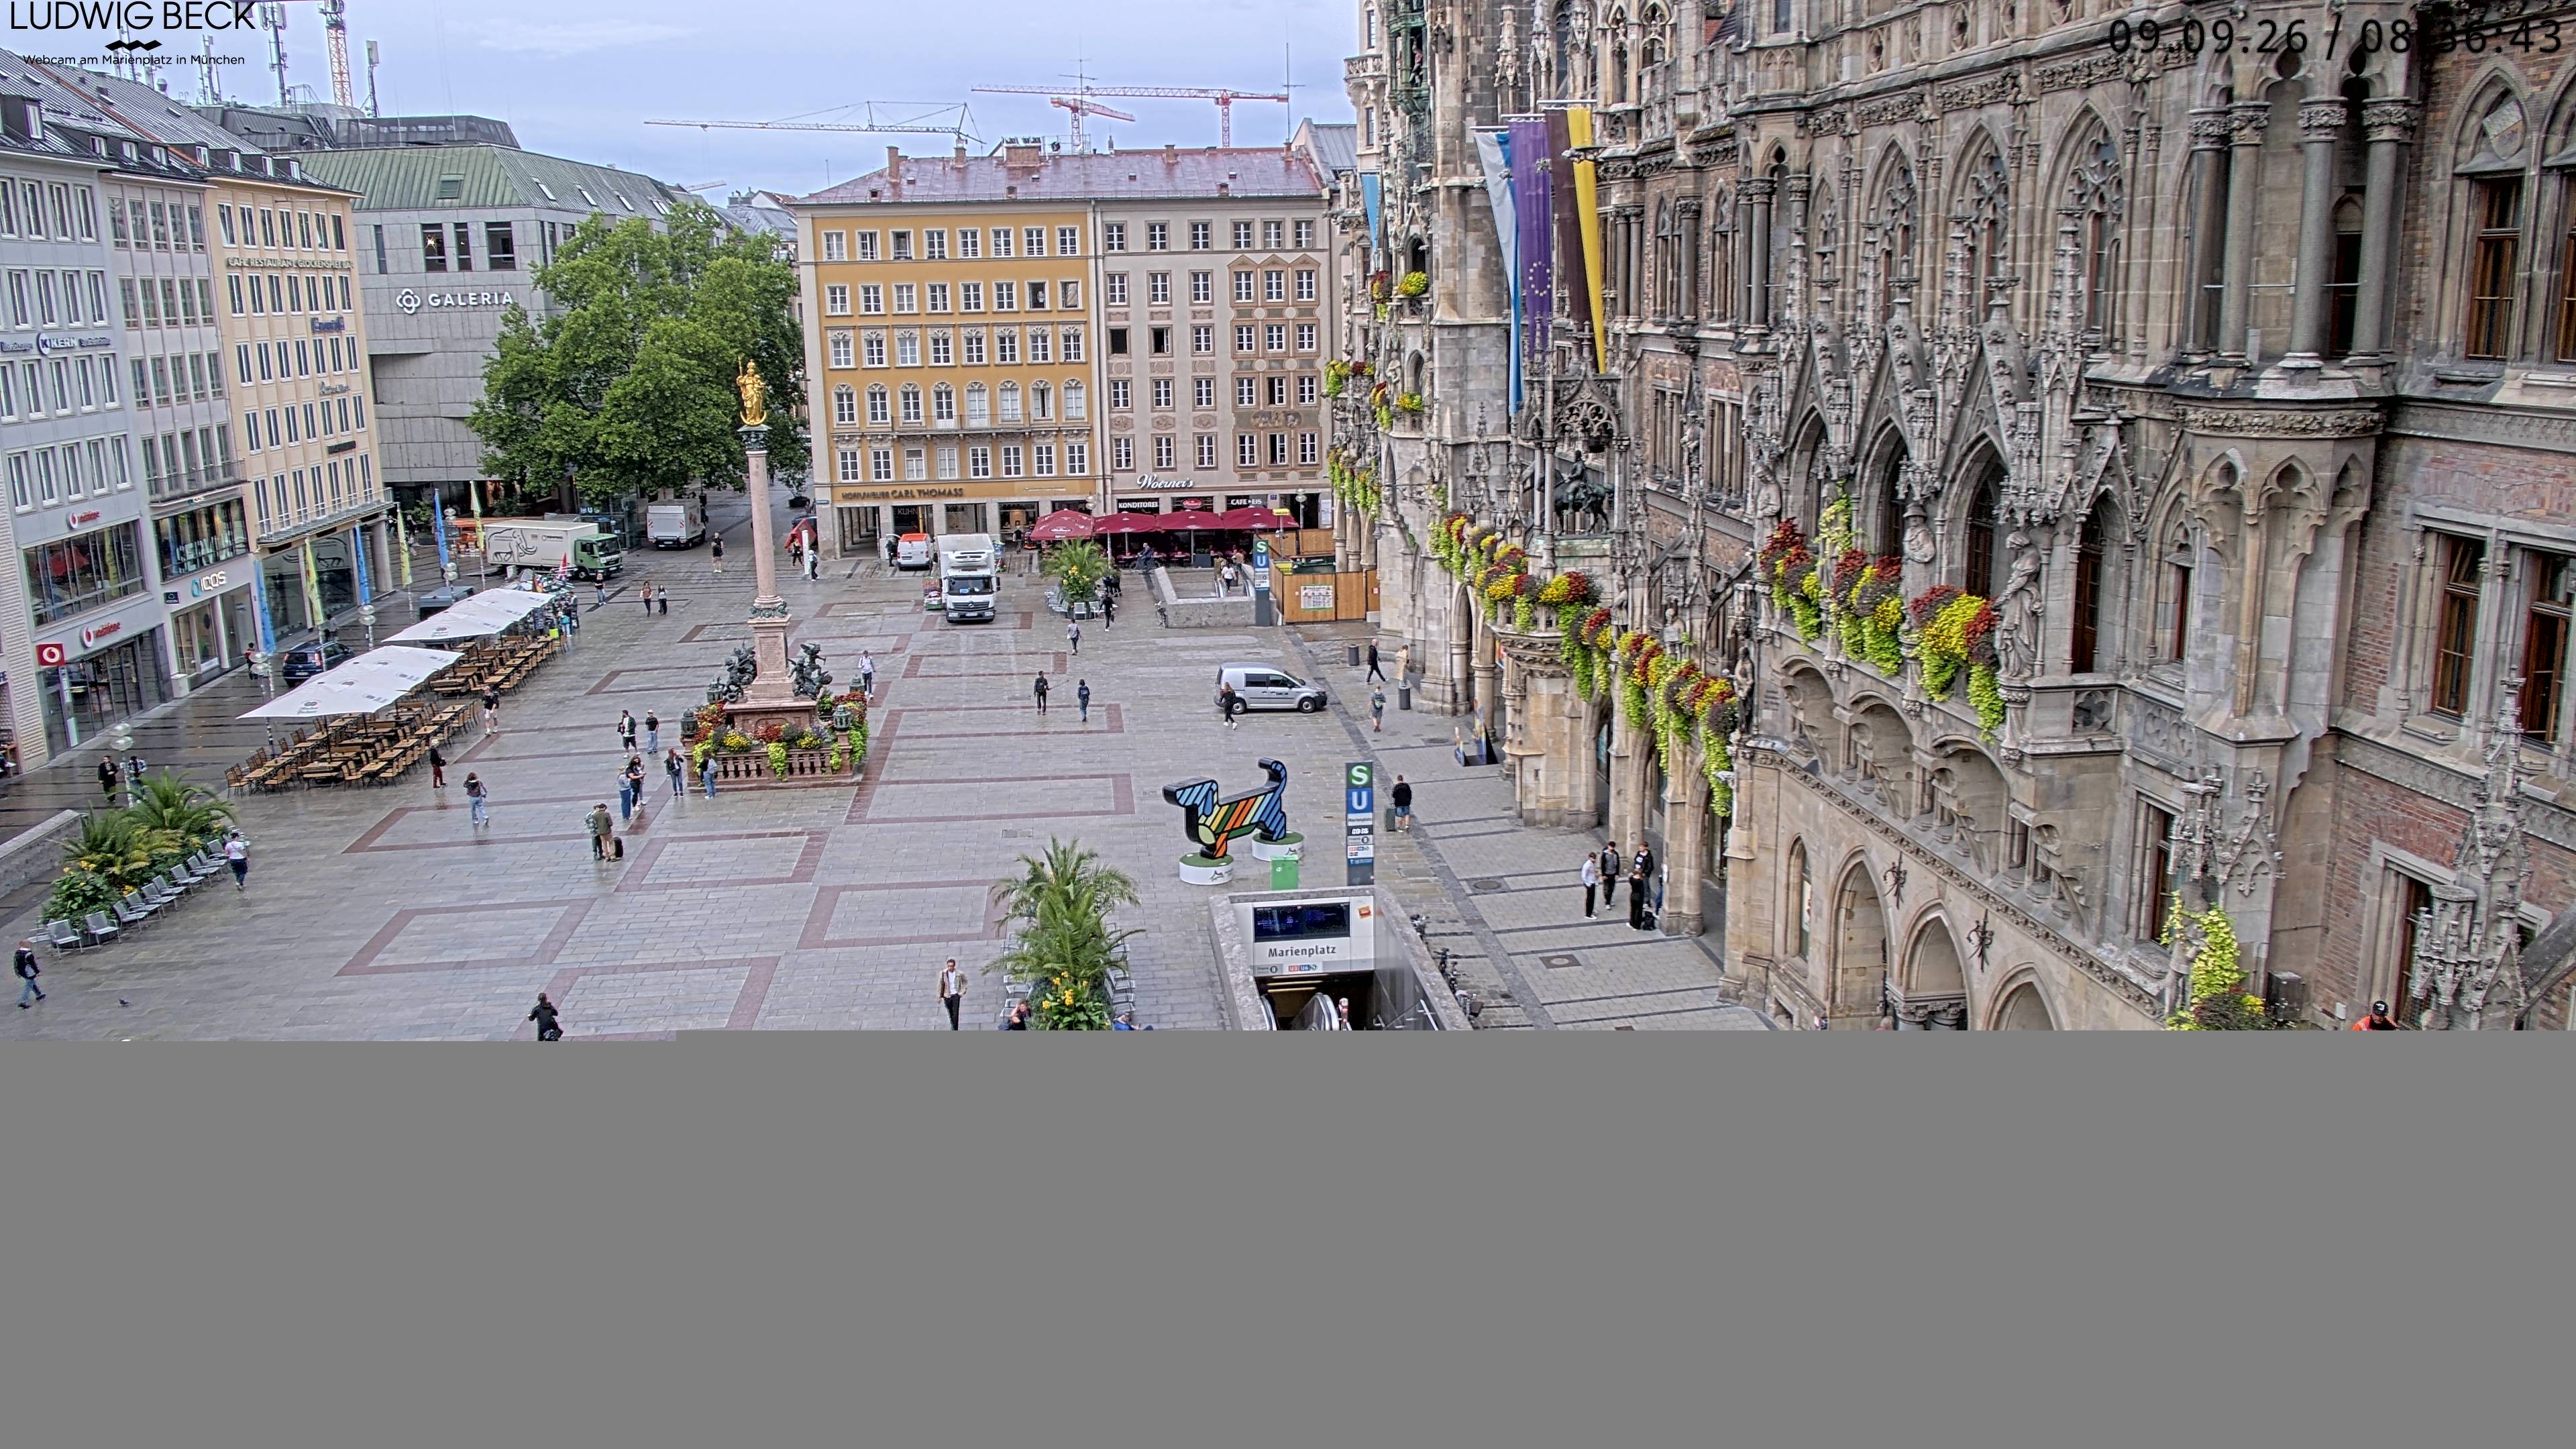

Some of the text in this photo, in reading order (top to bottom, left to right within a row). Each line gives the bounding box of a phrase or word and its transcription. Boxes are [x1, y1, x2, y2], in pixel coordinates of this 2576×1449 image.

[428, 292, 513, 307] GALERIA
[50, 337, 77, 349] KERN
[1136, 474, 1194, 489] Woerner's
[891, 489, 915, 499] CARL
[917, 488, 964, 498] THOMASS
[1256, 541, 1267, 553] S
[1256, 555, 1266, 567] U
[201, 571, 227, 591] IQOS
[1351, 765, 1368, 785] S
[1351, 791, 1368, 810] U
[1268, 945, 1337, 958] Marienplatz
